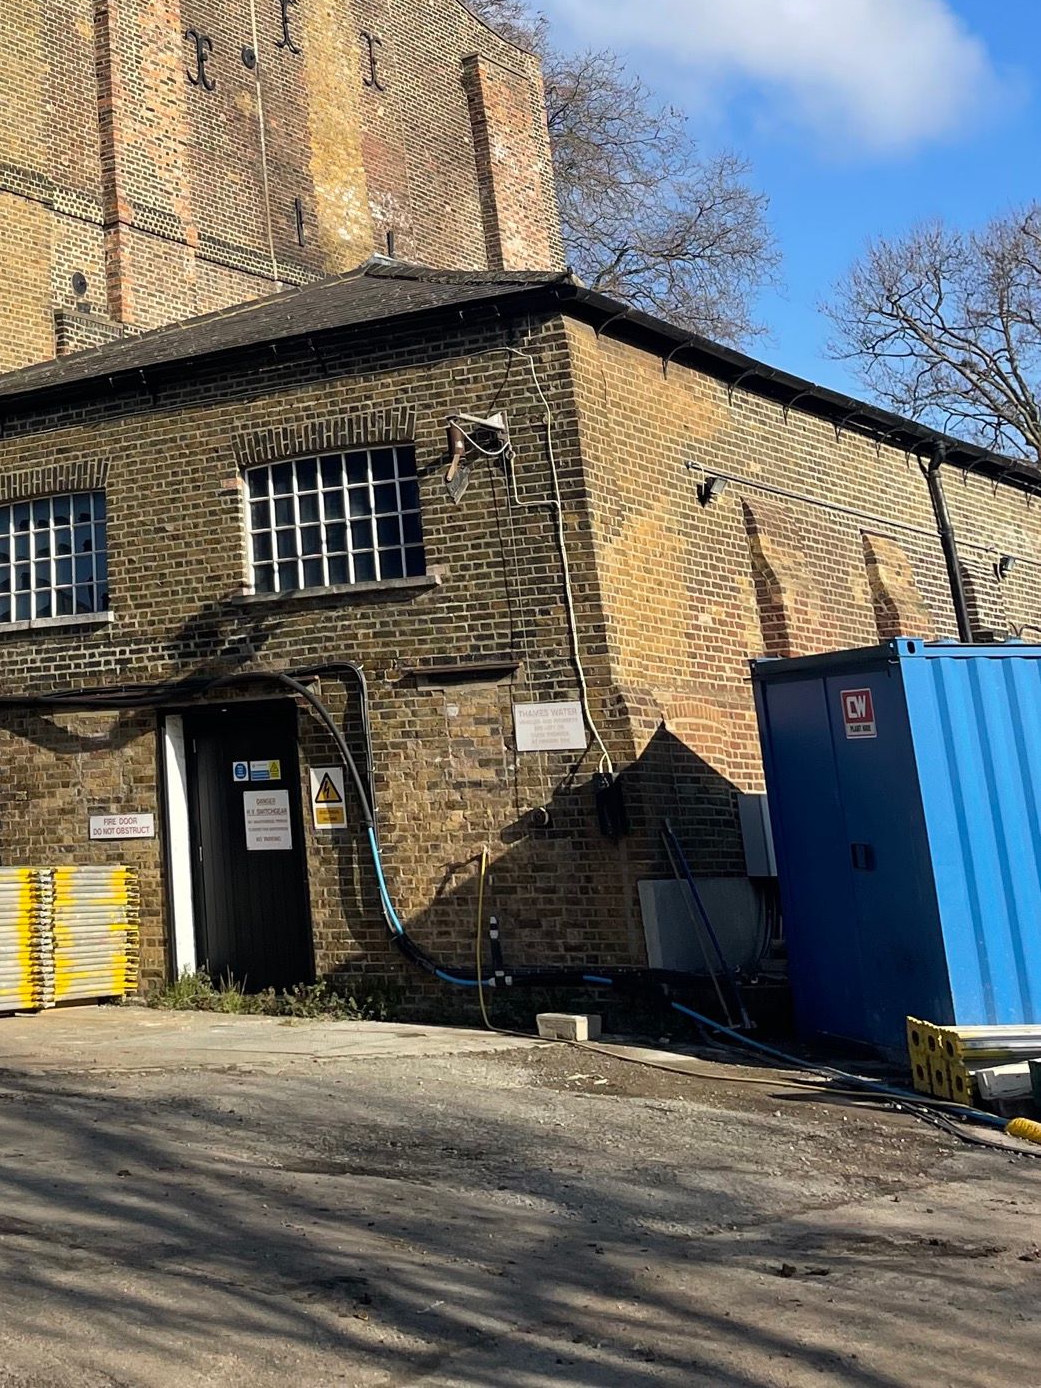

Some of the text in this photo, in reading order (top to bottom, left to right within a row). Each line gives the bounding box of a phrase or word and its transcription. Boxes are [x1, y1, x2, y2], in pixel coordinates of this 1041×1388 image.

[846, 695, 866, 718] CW
[550, 708, 577, 717] WATER
[119, 817, 138, 825] DOOR
[103, 827, 115, 835] NOT
[116, 827, 150, 835] OBSTRUCT
